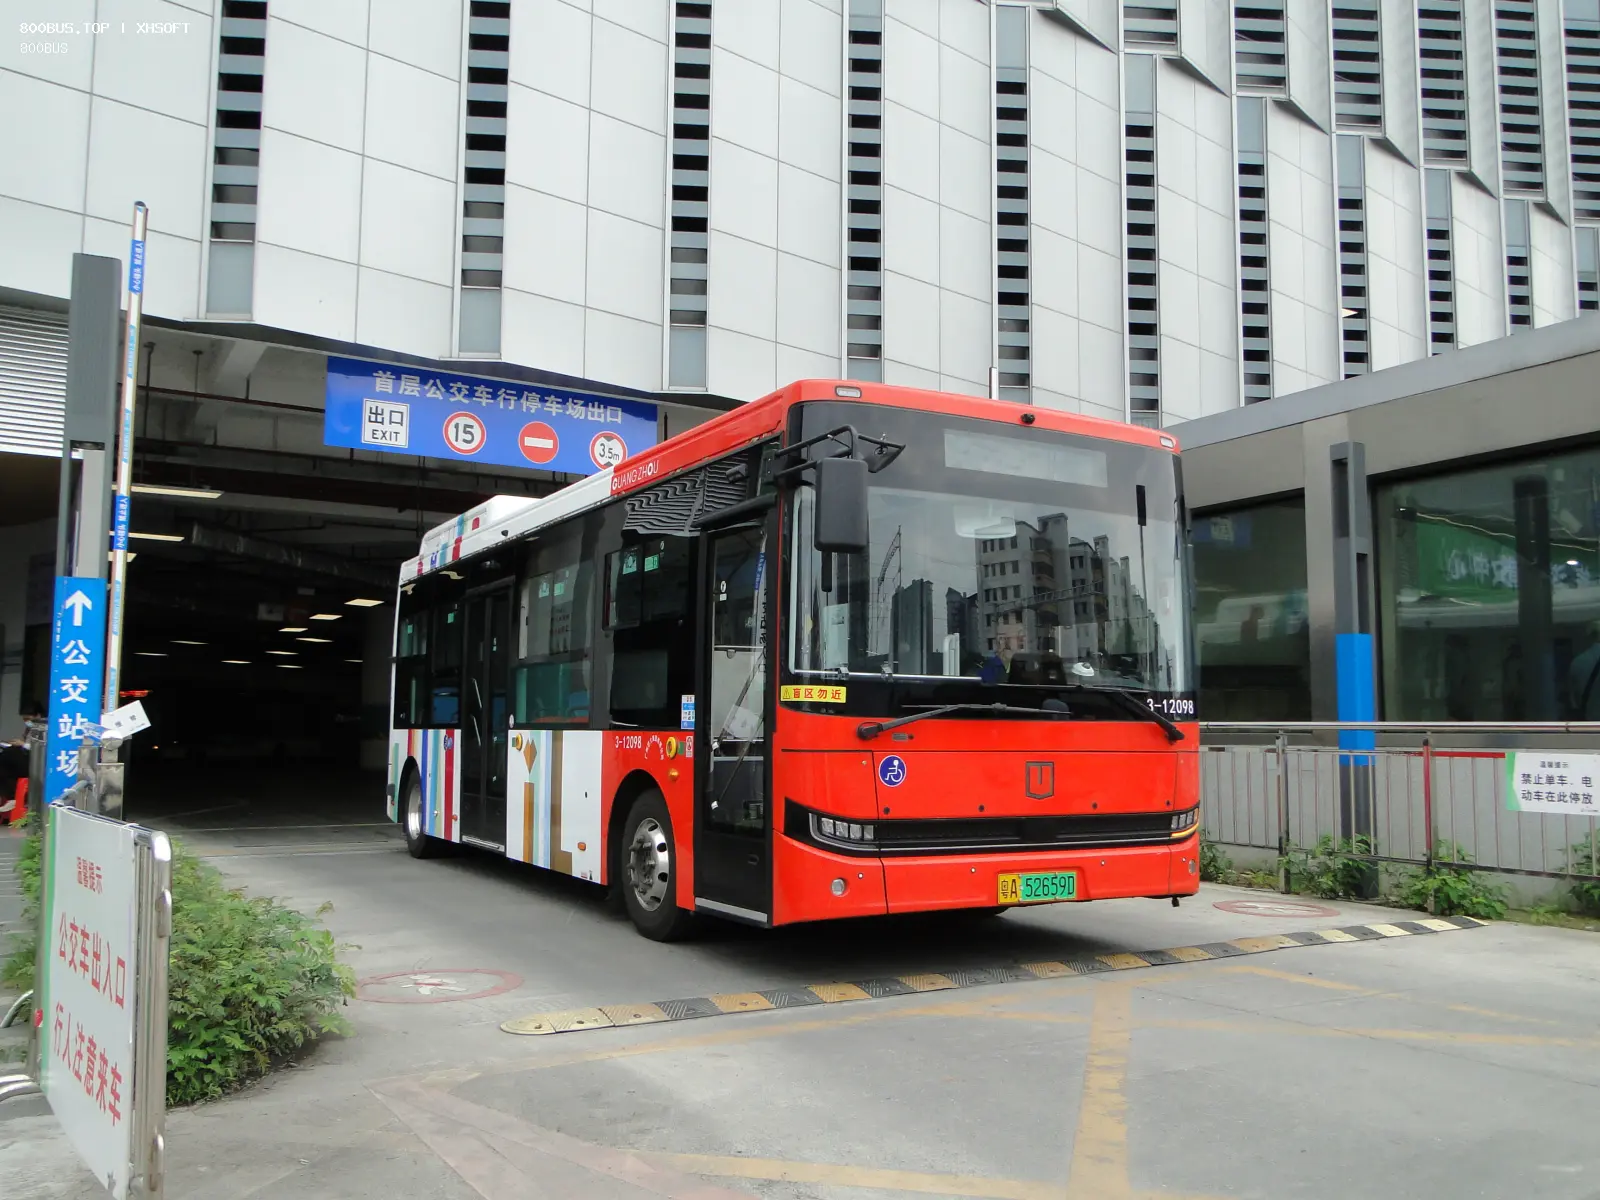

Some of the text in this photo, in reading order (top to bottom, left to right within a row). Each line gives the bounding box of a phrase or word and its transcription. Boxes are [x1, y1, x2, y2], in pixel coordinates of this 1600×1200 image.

[372, 370, 623, 425] 首层公交车行停车场出口
[368, 405, 404, 427] 出口
[371, 428, 401, 442] EXIT
[454, 422, 475, 445] 15
[598, 442, 620, 461] 3.5m
[793, 687, 842, 701] 盲区勿近
[1146, 698, 1195, 714] 3-12098
[615, 735, 642, 749] 3-12098
[1520, 789, 1593, 805] 动车在此停放
[1000, 875, 1075, 899] 粤A 52659D
[59, 911, 126, 1010] 公交车出入口
[54, 1000, 123, 1127] 行人注意来车
